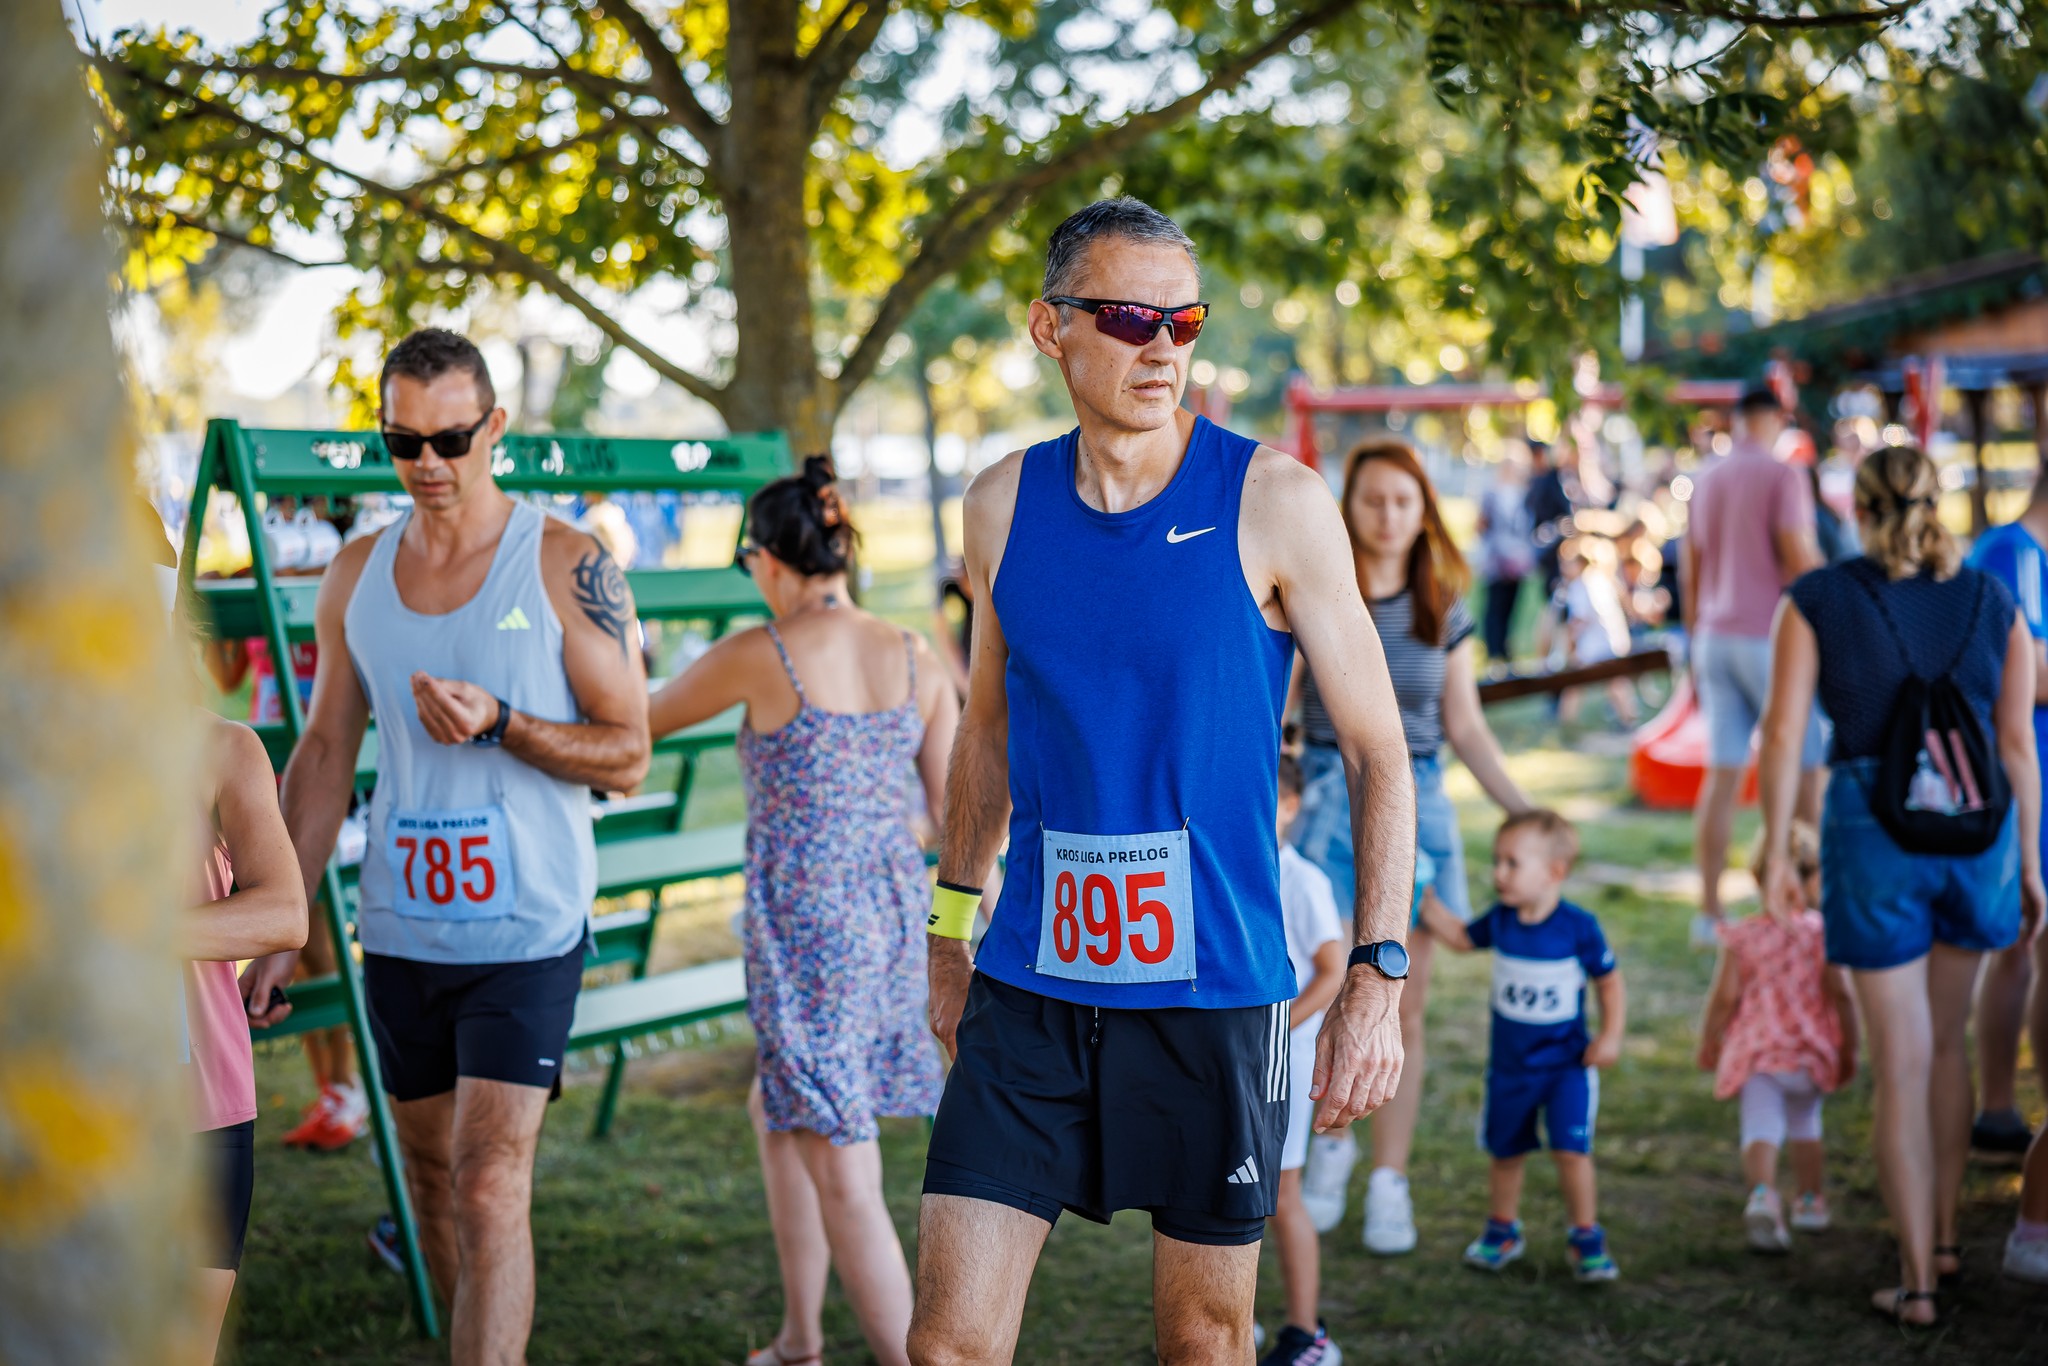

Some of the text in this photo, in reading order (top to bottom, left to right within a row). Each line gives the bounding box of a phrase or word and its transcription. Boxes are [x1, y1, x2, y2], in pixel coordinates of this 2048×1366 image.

[395, 834, 496, 905] 785
[1056, 847, 1168, 864] KROS LIGA PRELOG
[1052, 870, 1175, 967] 895
